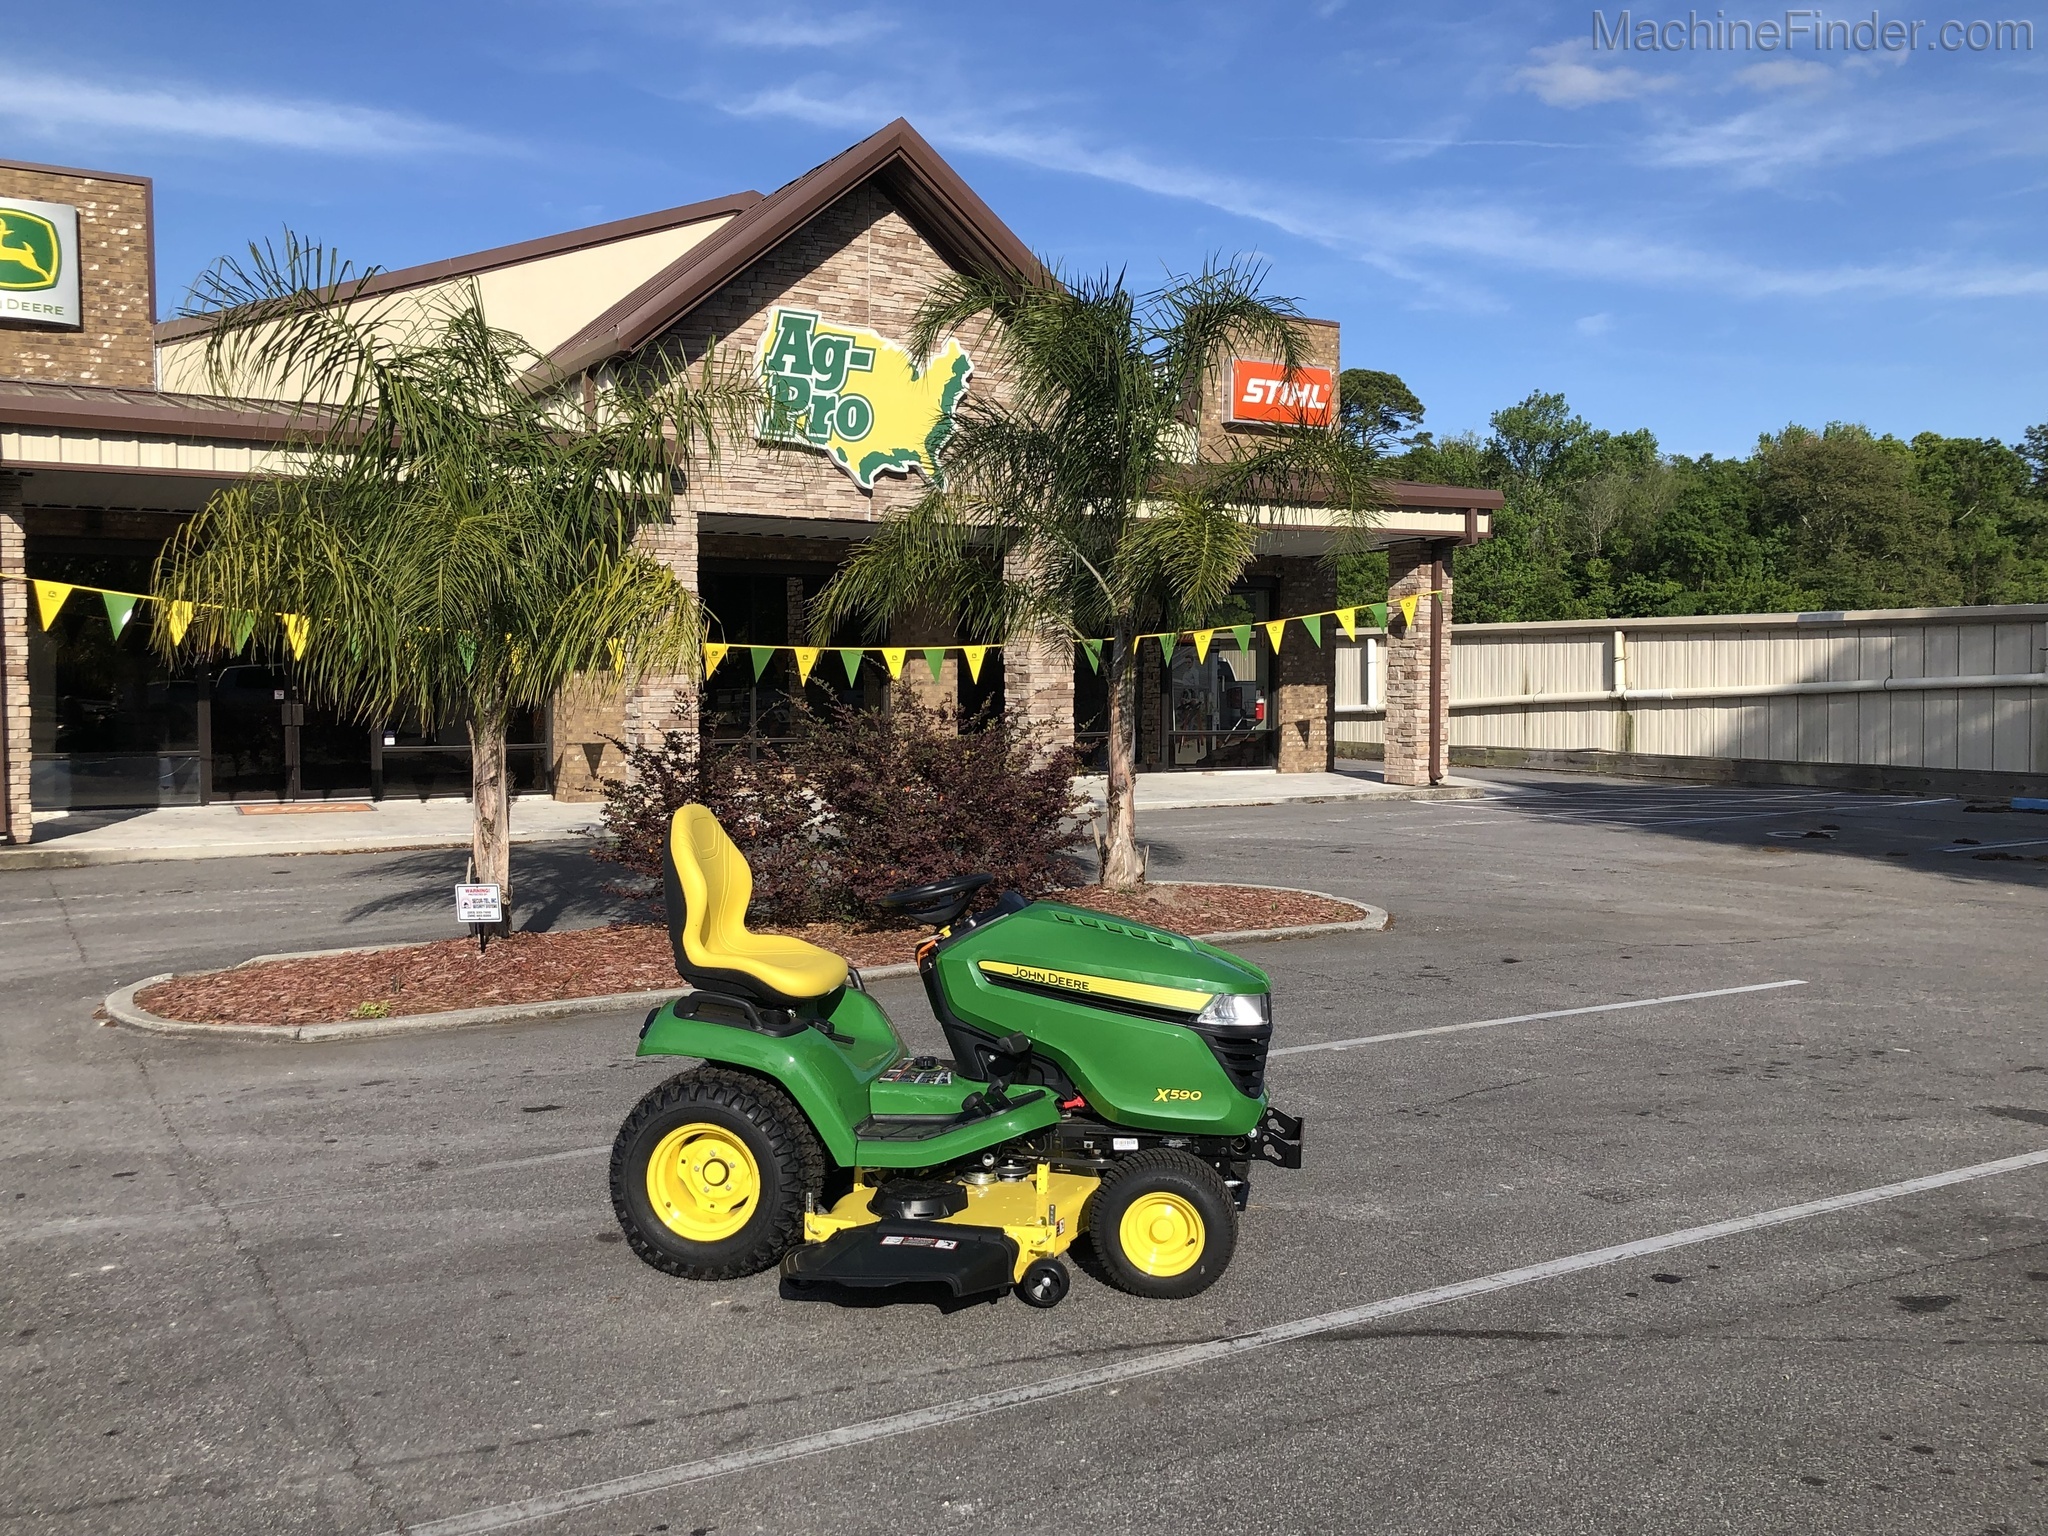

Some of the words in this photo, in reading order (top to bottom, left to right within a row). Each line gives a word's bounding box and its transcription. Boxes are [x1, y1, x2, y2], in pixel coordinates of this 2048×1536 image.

[7, 298, 65, 315] DEERE
[764, 310, 875, 391] Ag-
[762, 374, 873, 441] Pro
[1242, 378, 1326, 409] STIHL
[1012, 966, 1046, 982] JOHN
[1048, 972, 1090, 991] DEERE
[1154, 1088, 1202, 1103] X590
